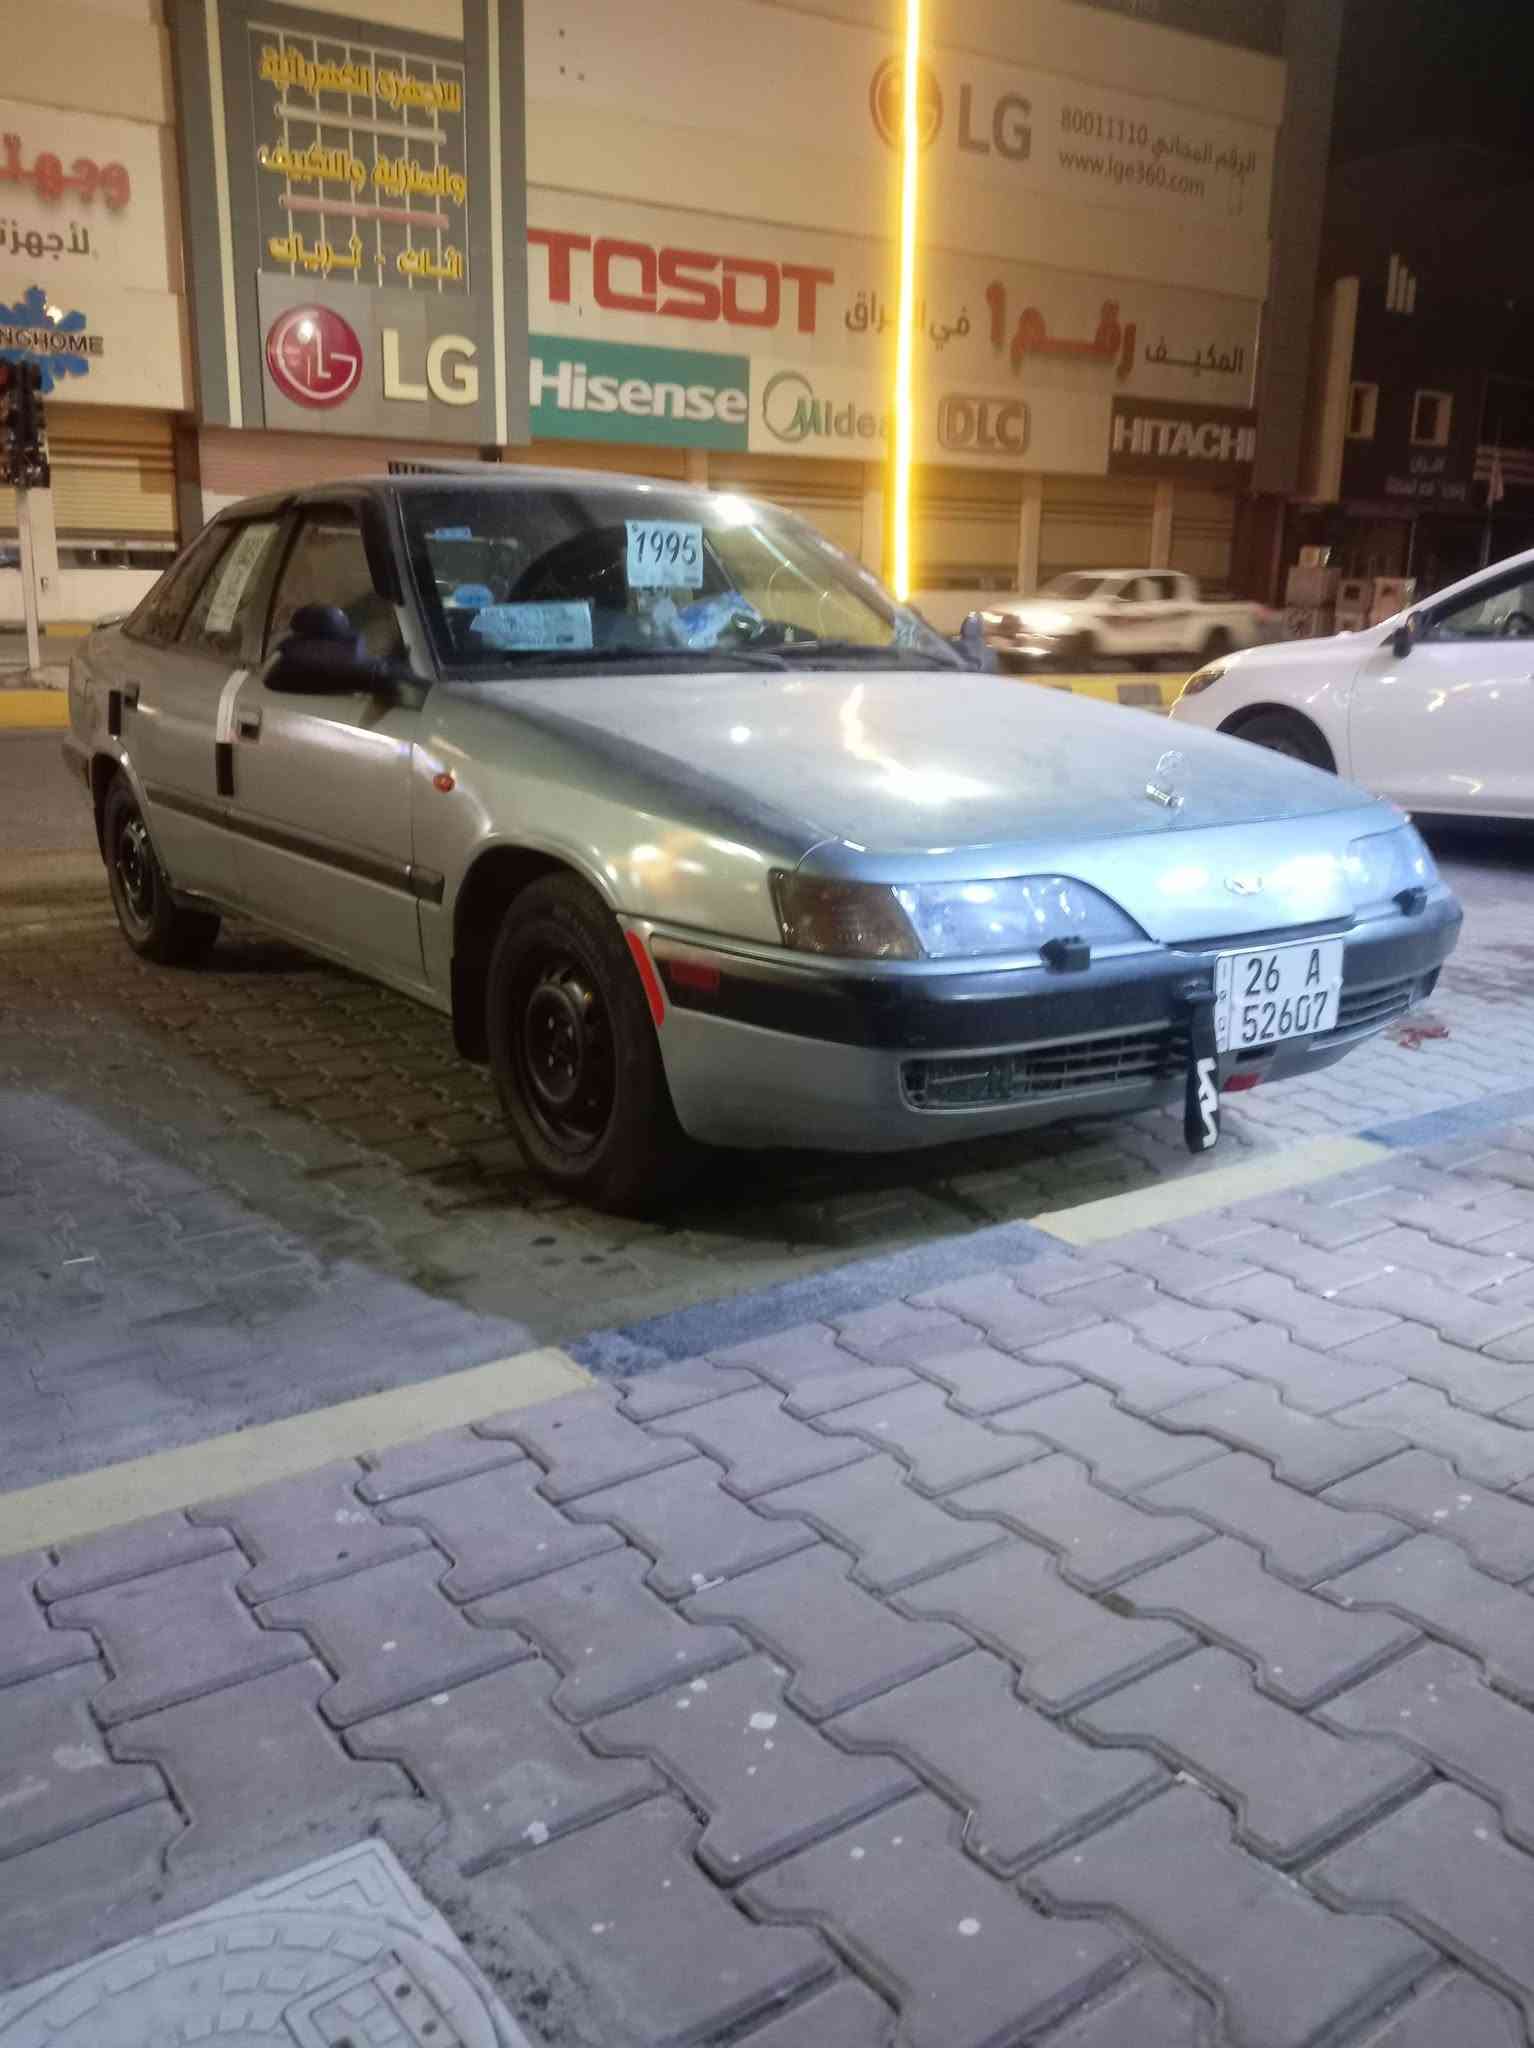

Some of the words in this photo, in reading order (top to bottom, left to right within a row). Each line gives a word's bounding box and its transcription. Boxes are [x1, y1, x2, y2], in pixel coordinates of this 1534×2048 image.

[956, 84, 1032, 161] LG
[527, 228, 835, 334] TOSOT
[928, 304, 971, 352] في
[382, 328, 480, 406] LG
[529, 357, 748, 424] Hisense
[944, 400, 1028, 452] DLC
[1111, 410, 1258, 462] HITACHI
[636, 530, 697, 566] 1995
[1244, 955, 1281, 997] 26
[1304, 948, 1321, 987] A
[1241, 991, 1329, 1043] 52607
